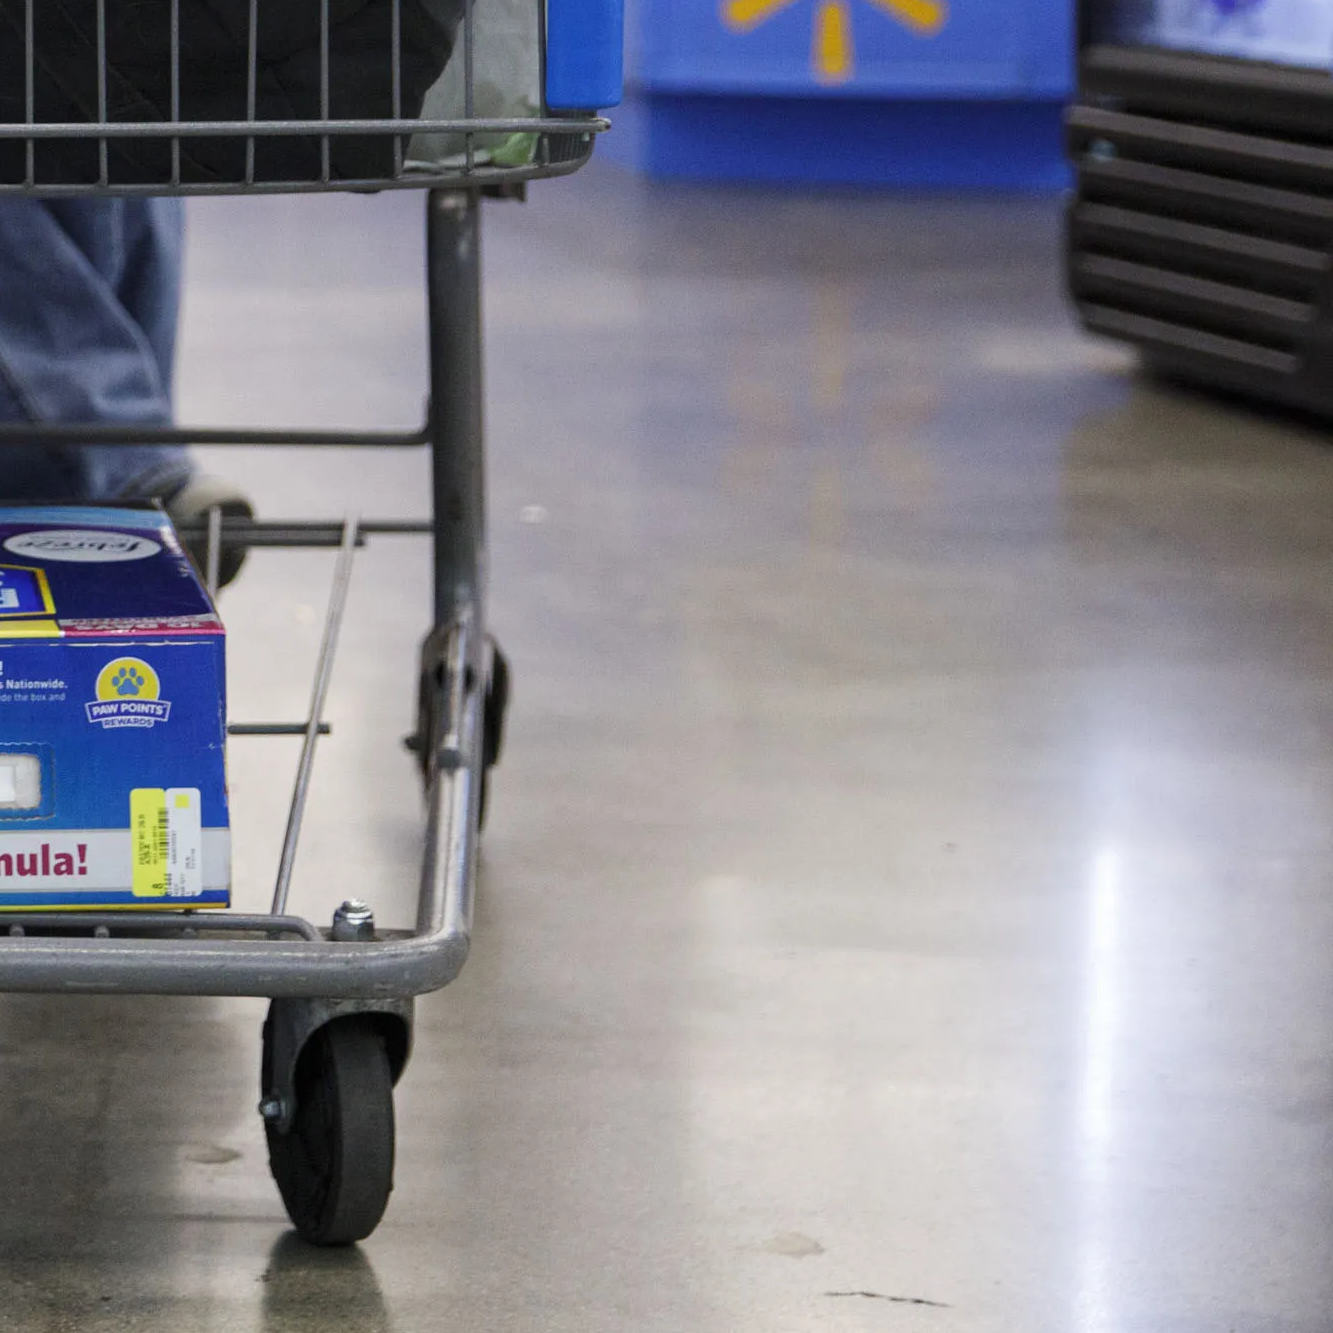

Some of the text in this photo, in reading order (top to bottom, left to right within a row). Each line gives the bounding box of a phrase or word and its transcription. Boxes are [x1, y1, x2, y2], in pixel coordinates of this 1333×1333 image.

[6, 679, 69, 690] Nationwide.
[14, 693, 29, 701] the
[31, 692, 47, 701] box
[49, 692, 66, 701] and
[92, 702, 163, 716] PAW POINTS
[104, 717, 153, 727] REWARDS
